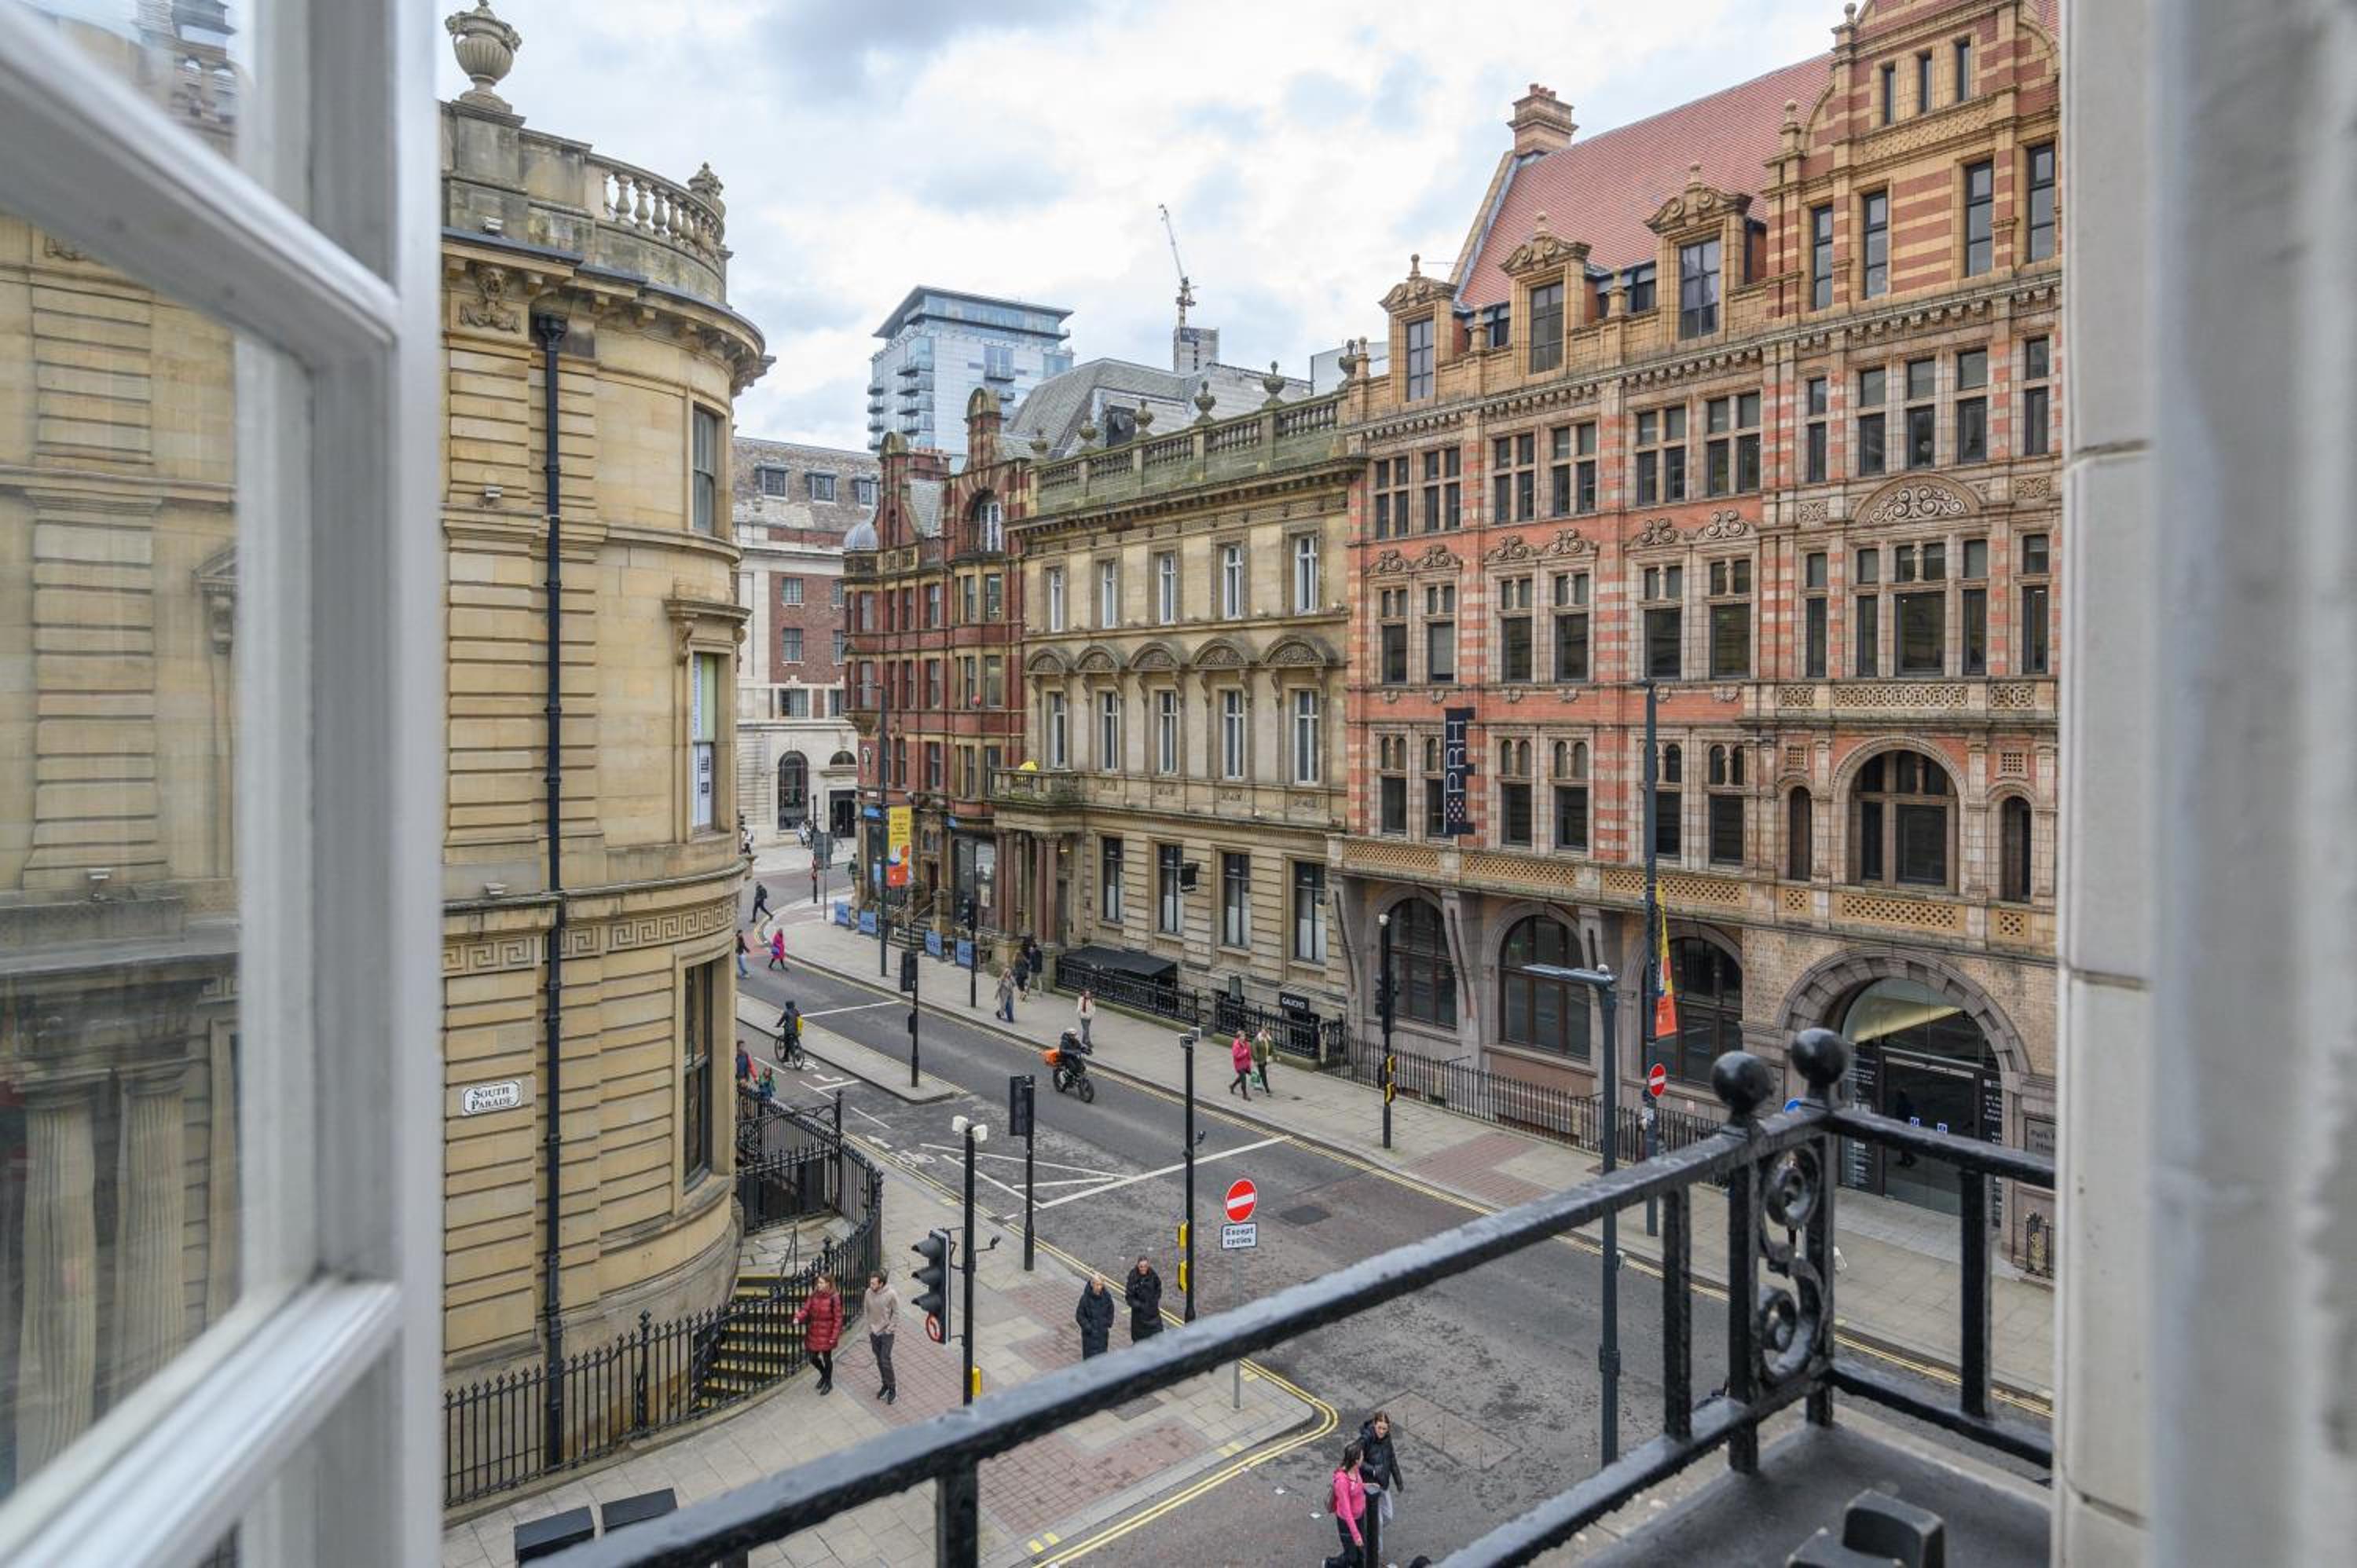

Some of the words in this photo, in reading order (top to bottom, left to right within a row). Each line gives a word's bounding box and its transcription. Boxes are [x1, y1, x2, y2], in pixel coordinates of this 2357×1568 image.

[1447, 720, 1465, 793] PRH
[472, 1086, 510, 1099] SOUTH
[471, 1097, 512, 1109] PARADE
[1226, 1227, 1254, 1236] Except
